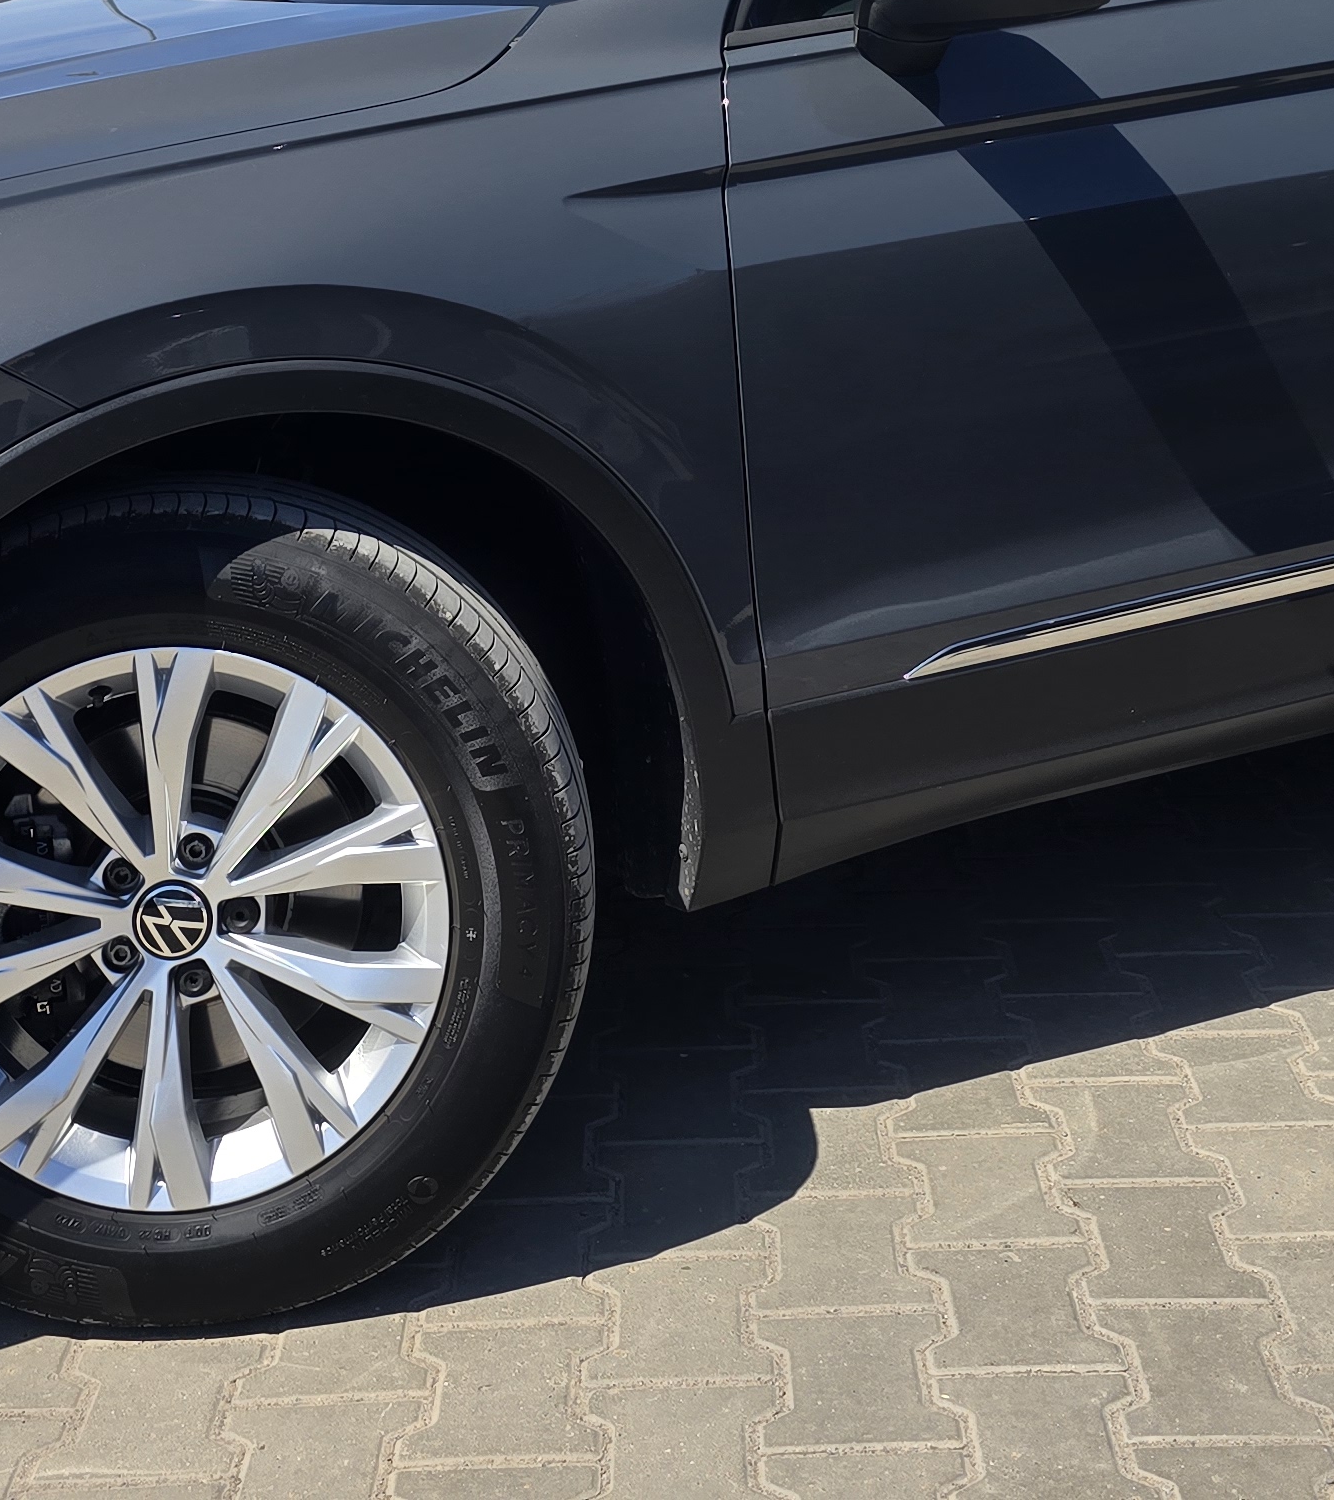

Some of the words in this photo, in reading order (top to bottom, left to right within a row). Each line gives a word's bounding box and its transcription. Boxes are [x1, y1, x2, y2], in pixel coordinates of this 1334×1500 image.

[311, 590, 509, 779] MICHELIN
[500, 818, 539, 958] PRIMACY
[352, 1204, 412, 1253] MICHELIN
